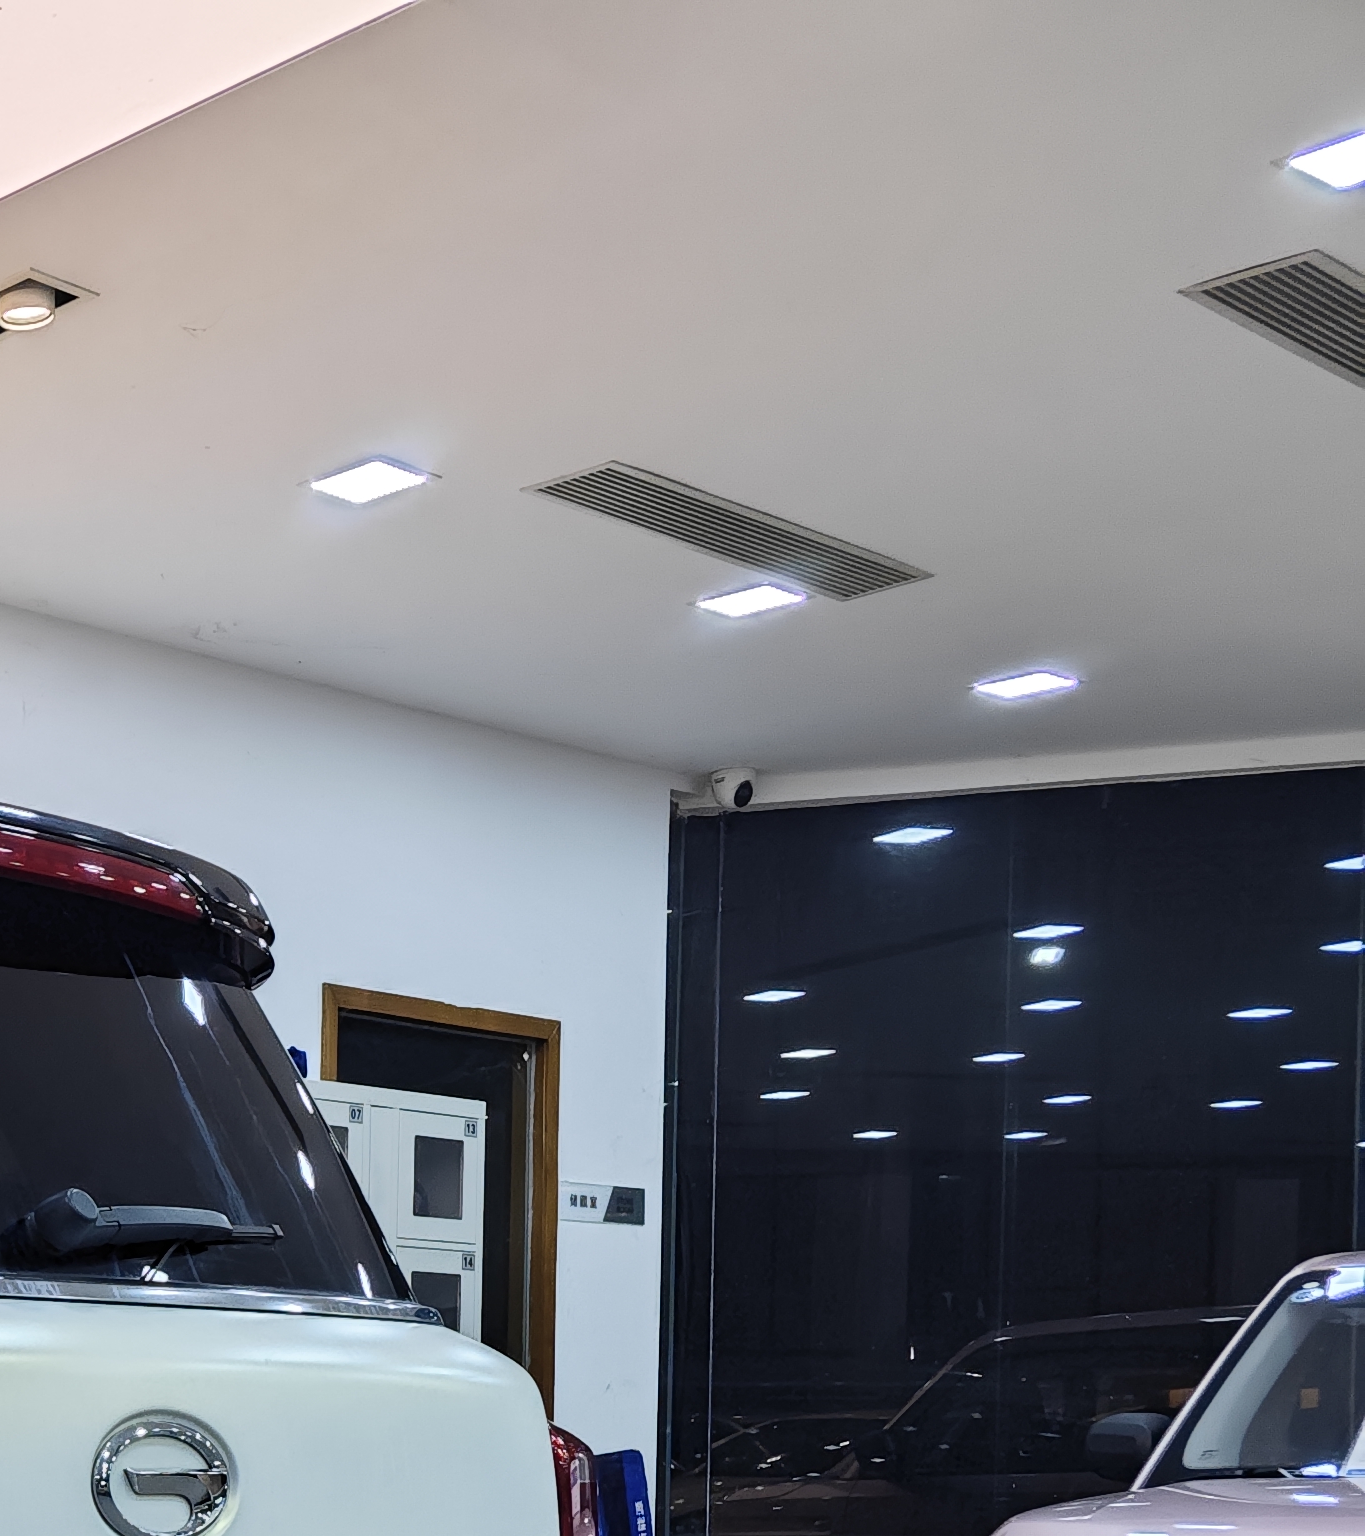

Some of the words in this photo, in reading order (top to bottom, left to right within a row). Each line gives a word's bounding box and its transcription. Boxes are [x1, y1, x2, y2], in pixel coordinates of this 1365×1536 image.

[350, 1108, 362, 1121] 07
[466, 1121, 476, 1135] 13
[463, 1255, 474, 1269] 14
